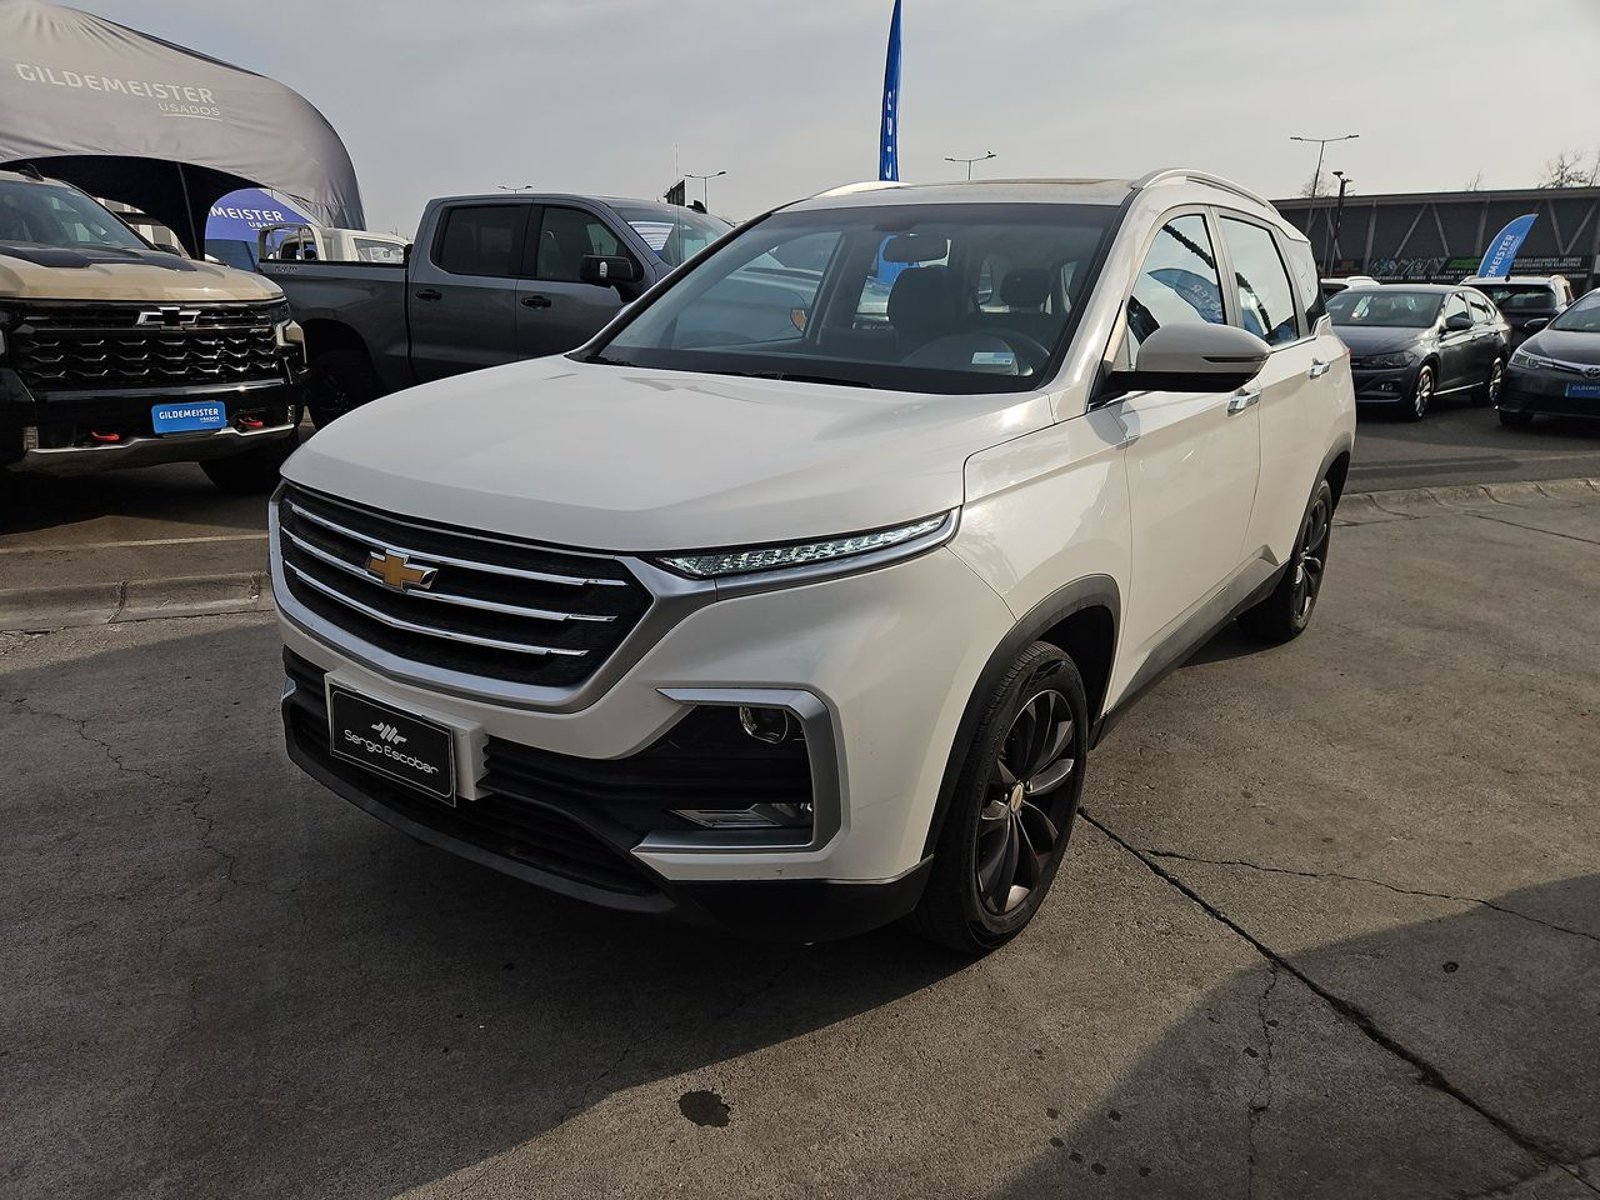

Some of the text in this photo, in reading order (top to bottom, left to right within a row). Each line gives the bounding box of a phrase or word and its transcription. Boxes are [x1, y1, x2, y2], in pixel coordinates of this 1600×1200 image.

[15, 63, 216, 104] GILDEMEISTER
[158, 102, 221, 116] USADOS
[208, 206, 285, 221] MEISTER
[159, 408, 219, 419] GILDEMEISTER
[344, 729, 439, 775] Sergo Escobar
